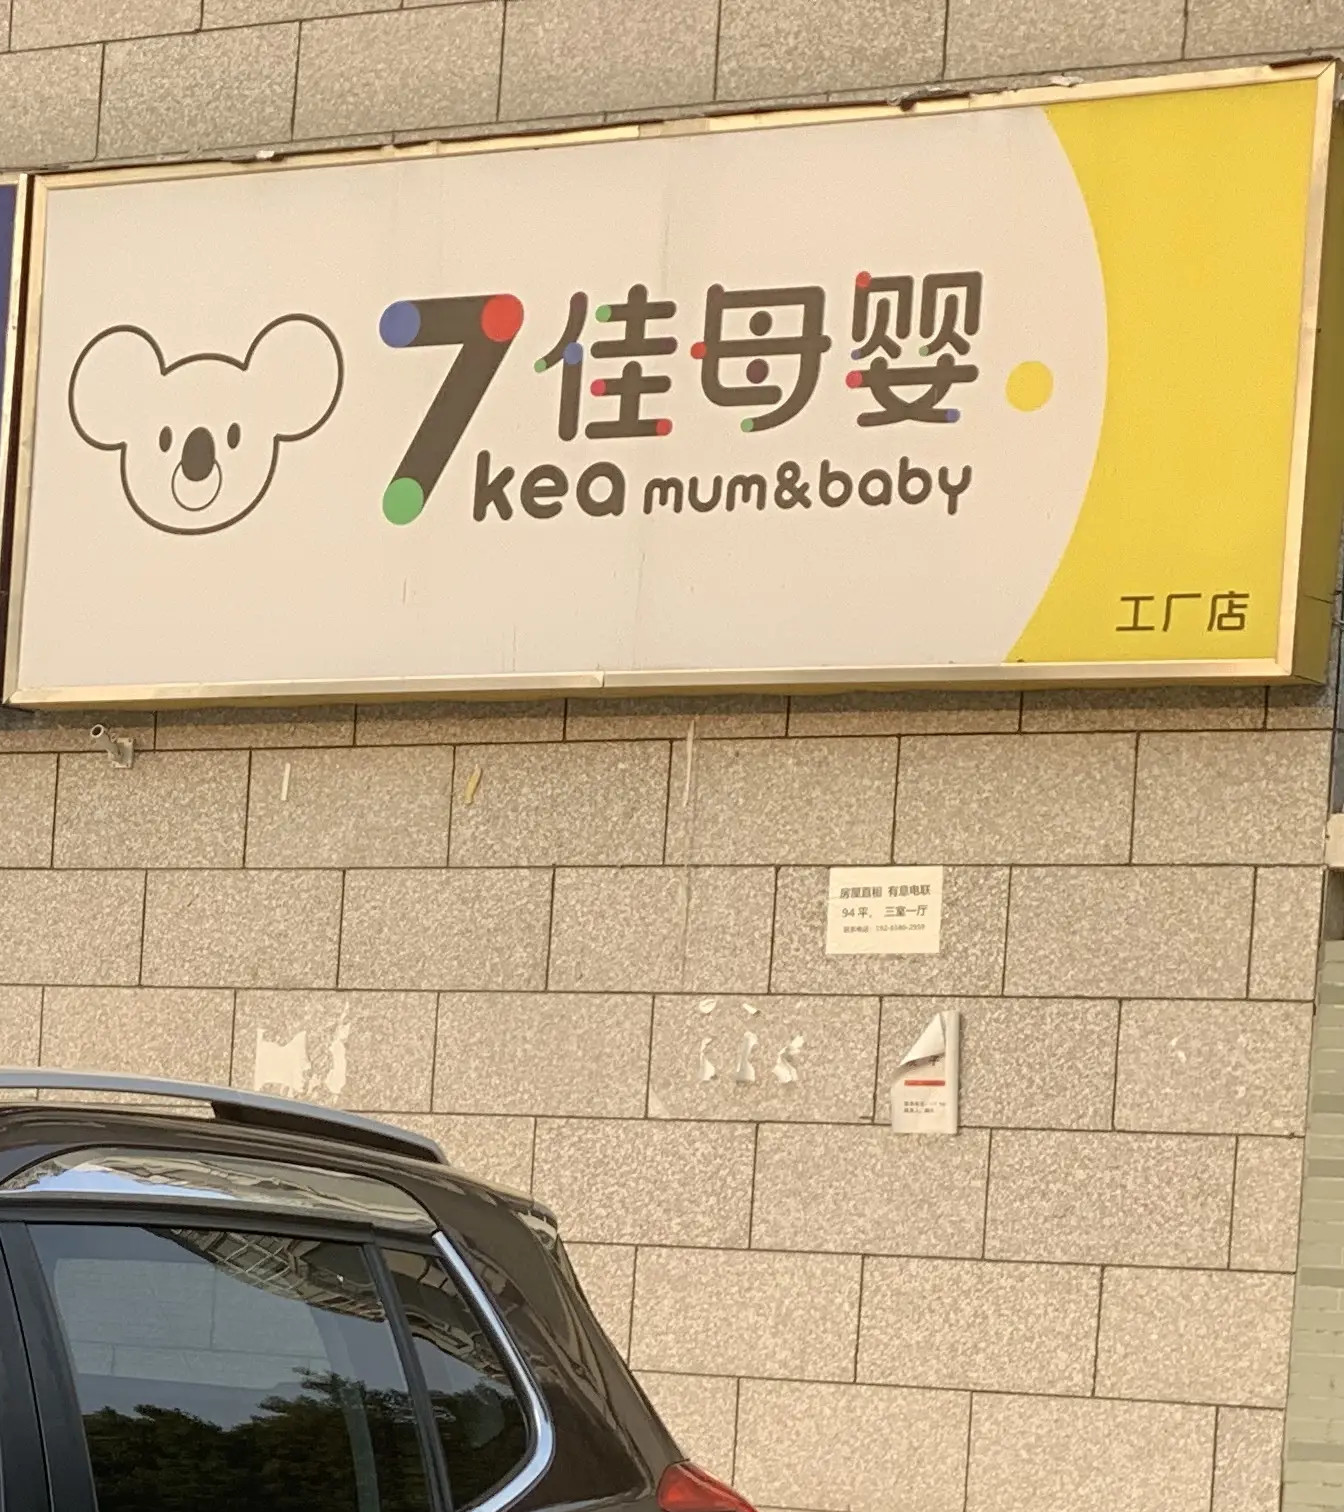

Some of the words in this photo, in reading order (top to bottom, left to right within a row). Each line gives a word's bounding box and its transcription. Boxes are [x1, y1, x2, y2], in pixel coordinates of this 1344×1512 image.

[643, 456, 973, 517] mum&baby
[1115, 590, 1250, 632] 工厂店
